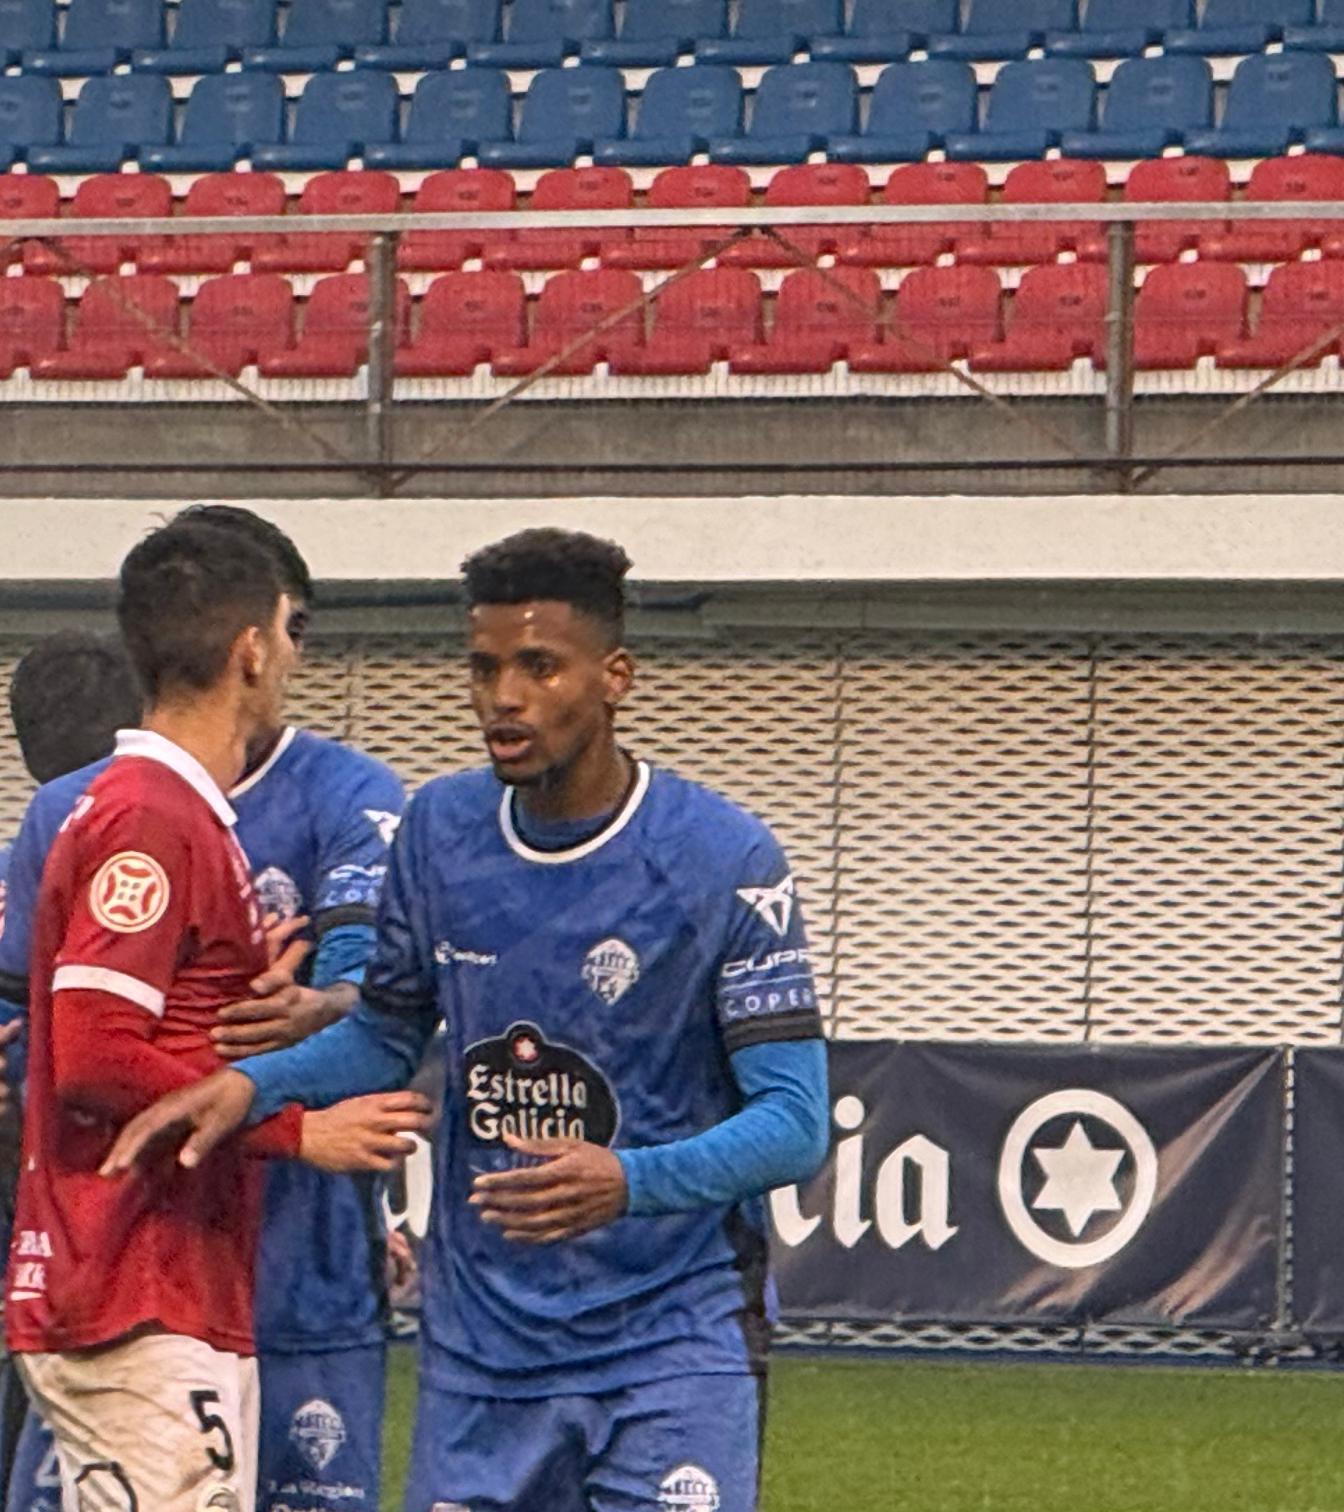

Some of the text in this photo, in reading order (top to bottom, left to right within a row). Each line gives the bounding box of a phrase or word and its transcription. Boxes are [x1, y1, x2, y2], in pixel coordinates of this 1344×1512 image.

[466, 1063, 588, 1109] Estrella
[470, 1101, 586, 1141] Galicia
[189, 1390, 234, 1471] 5
